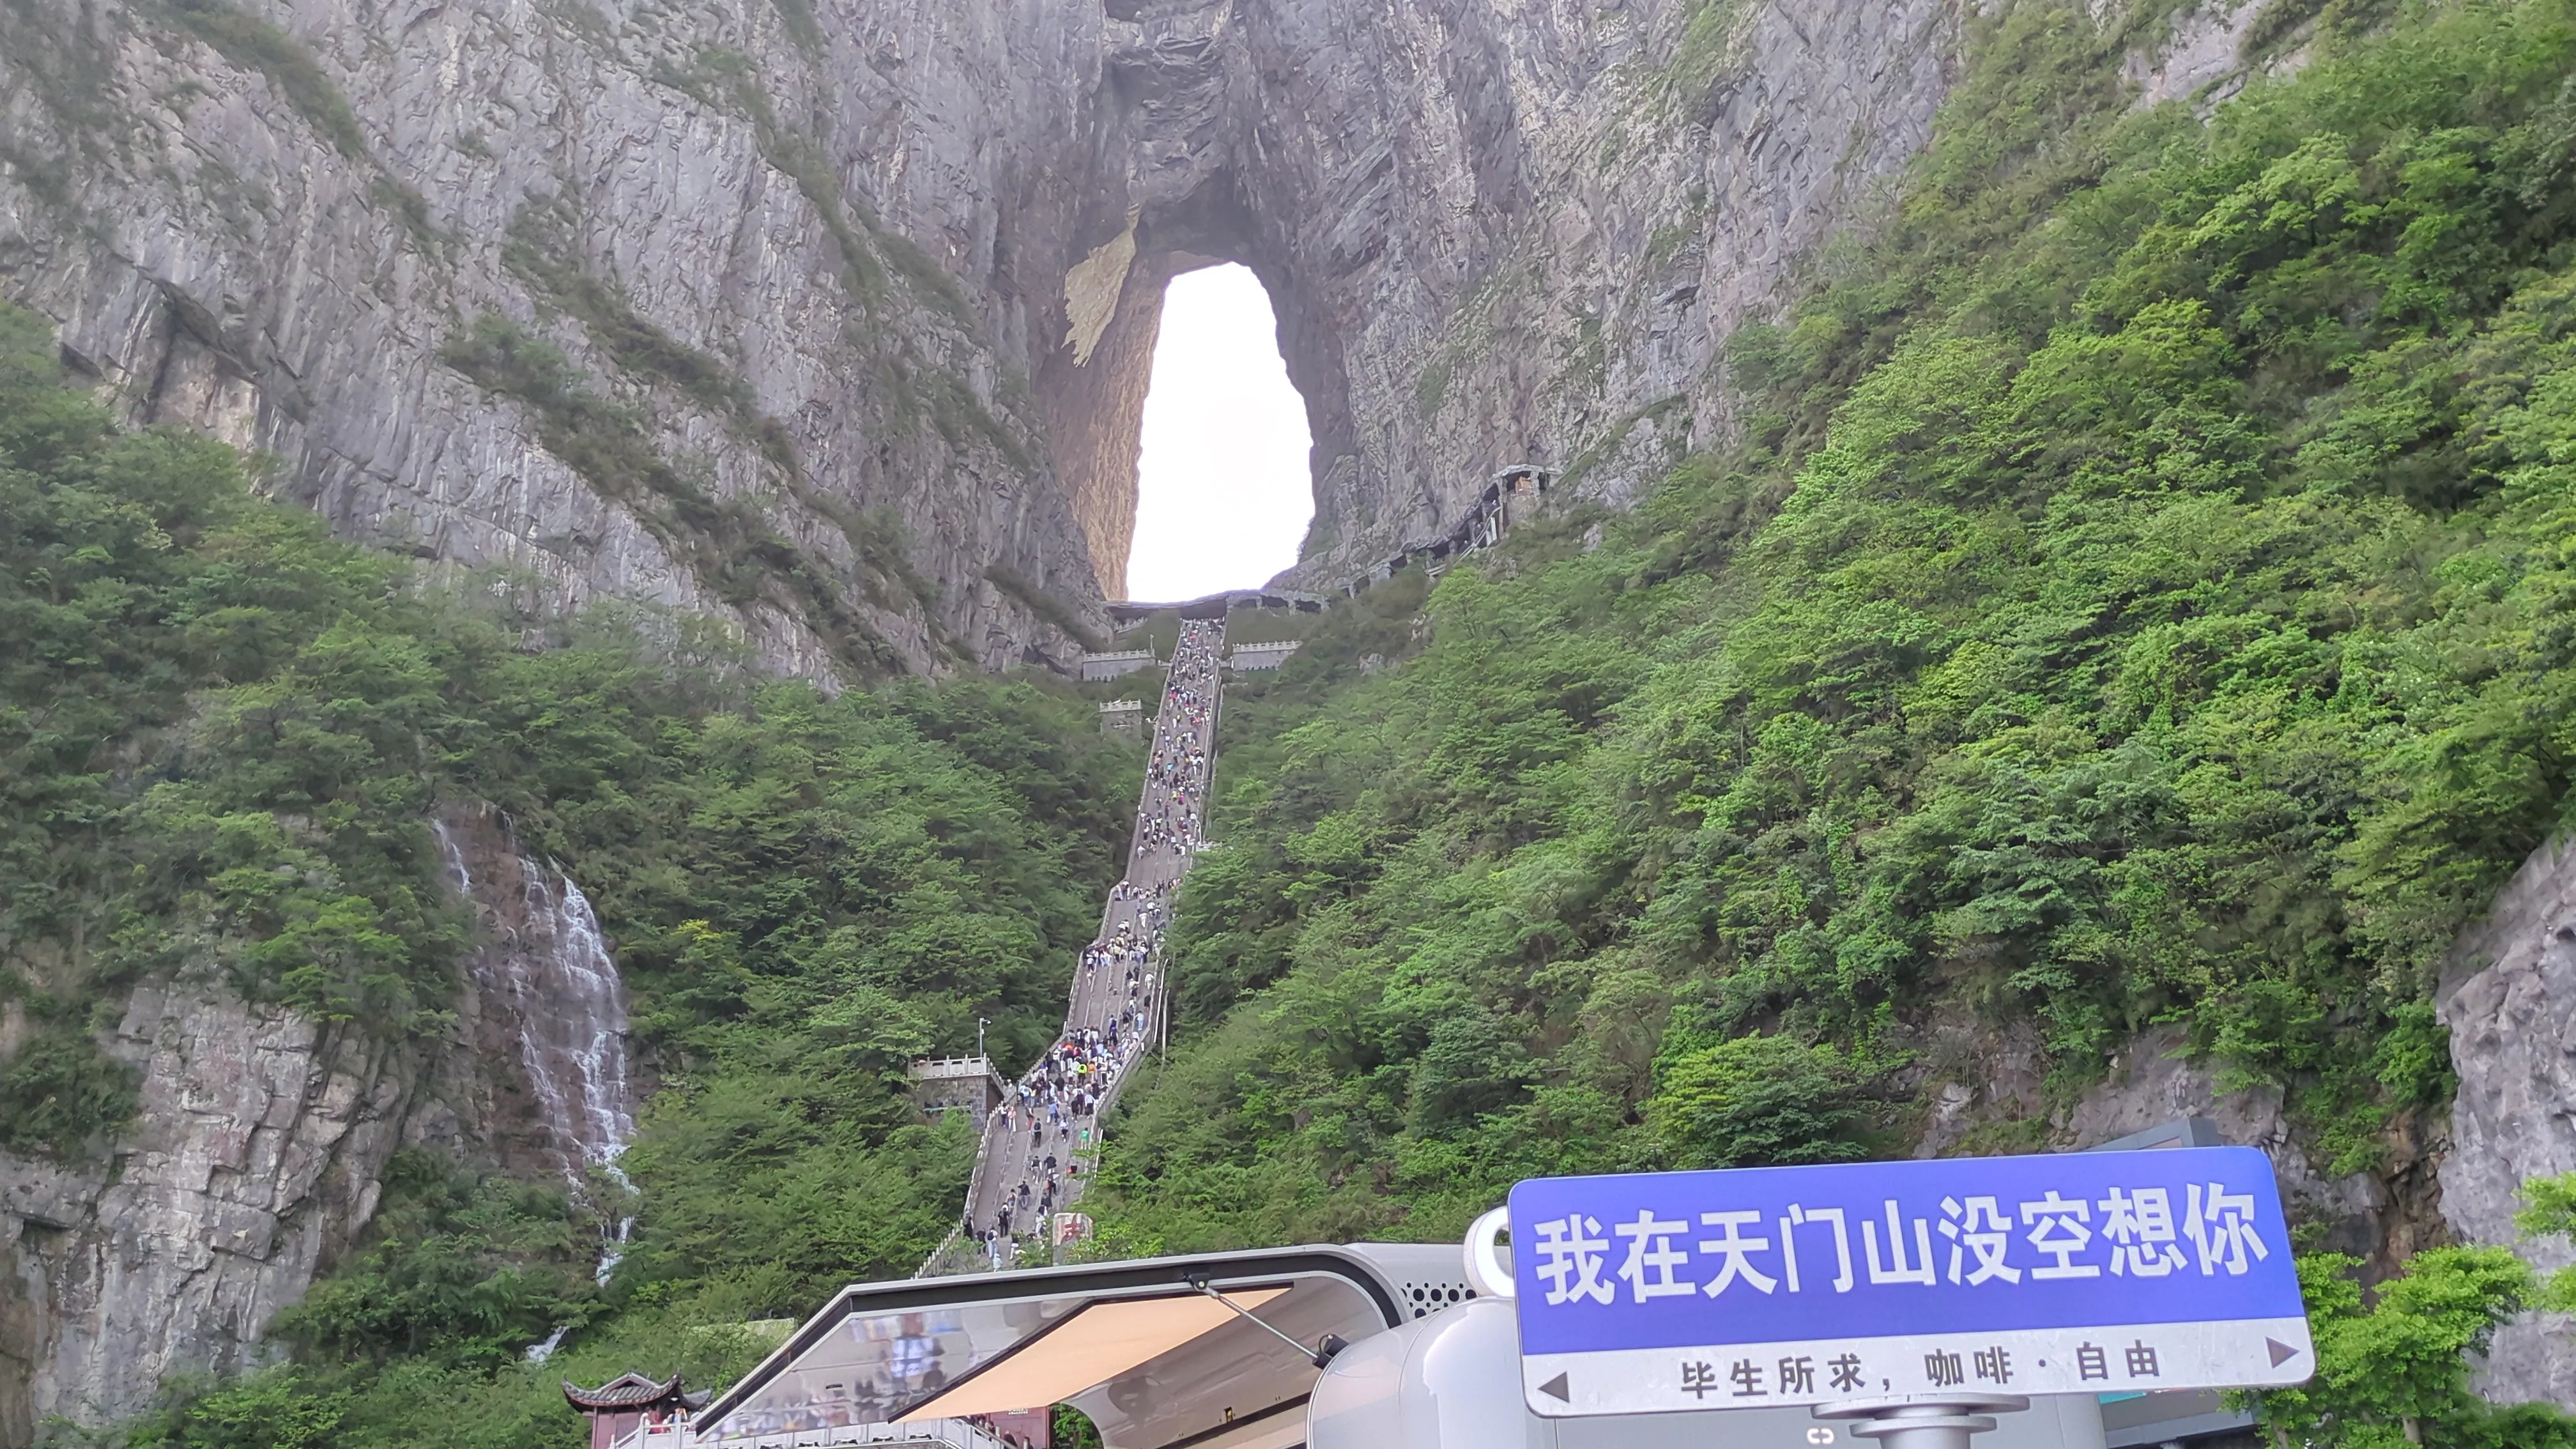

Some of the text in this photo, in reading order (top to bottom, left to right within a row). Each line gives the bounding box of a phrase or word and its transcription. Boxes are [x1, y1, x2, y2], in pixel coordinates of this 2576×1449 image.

[1533, 1182, 2269, 1306] 我在天门山没空想你
